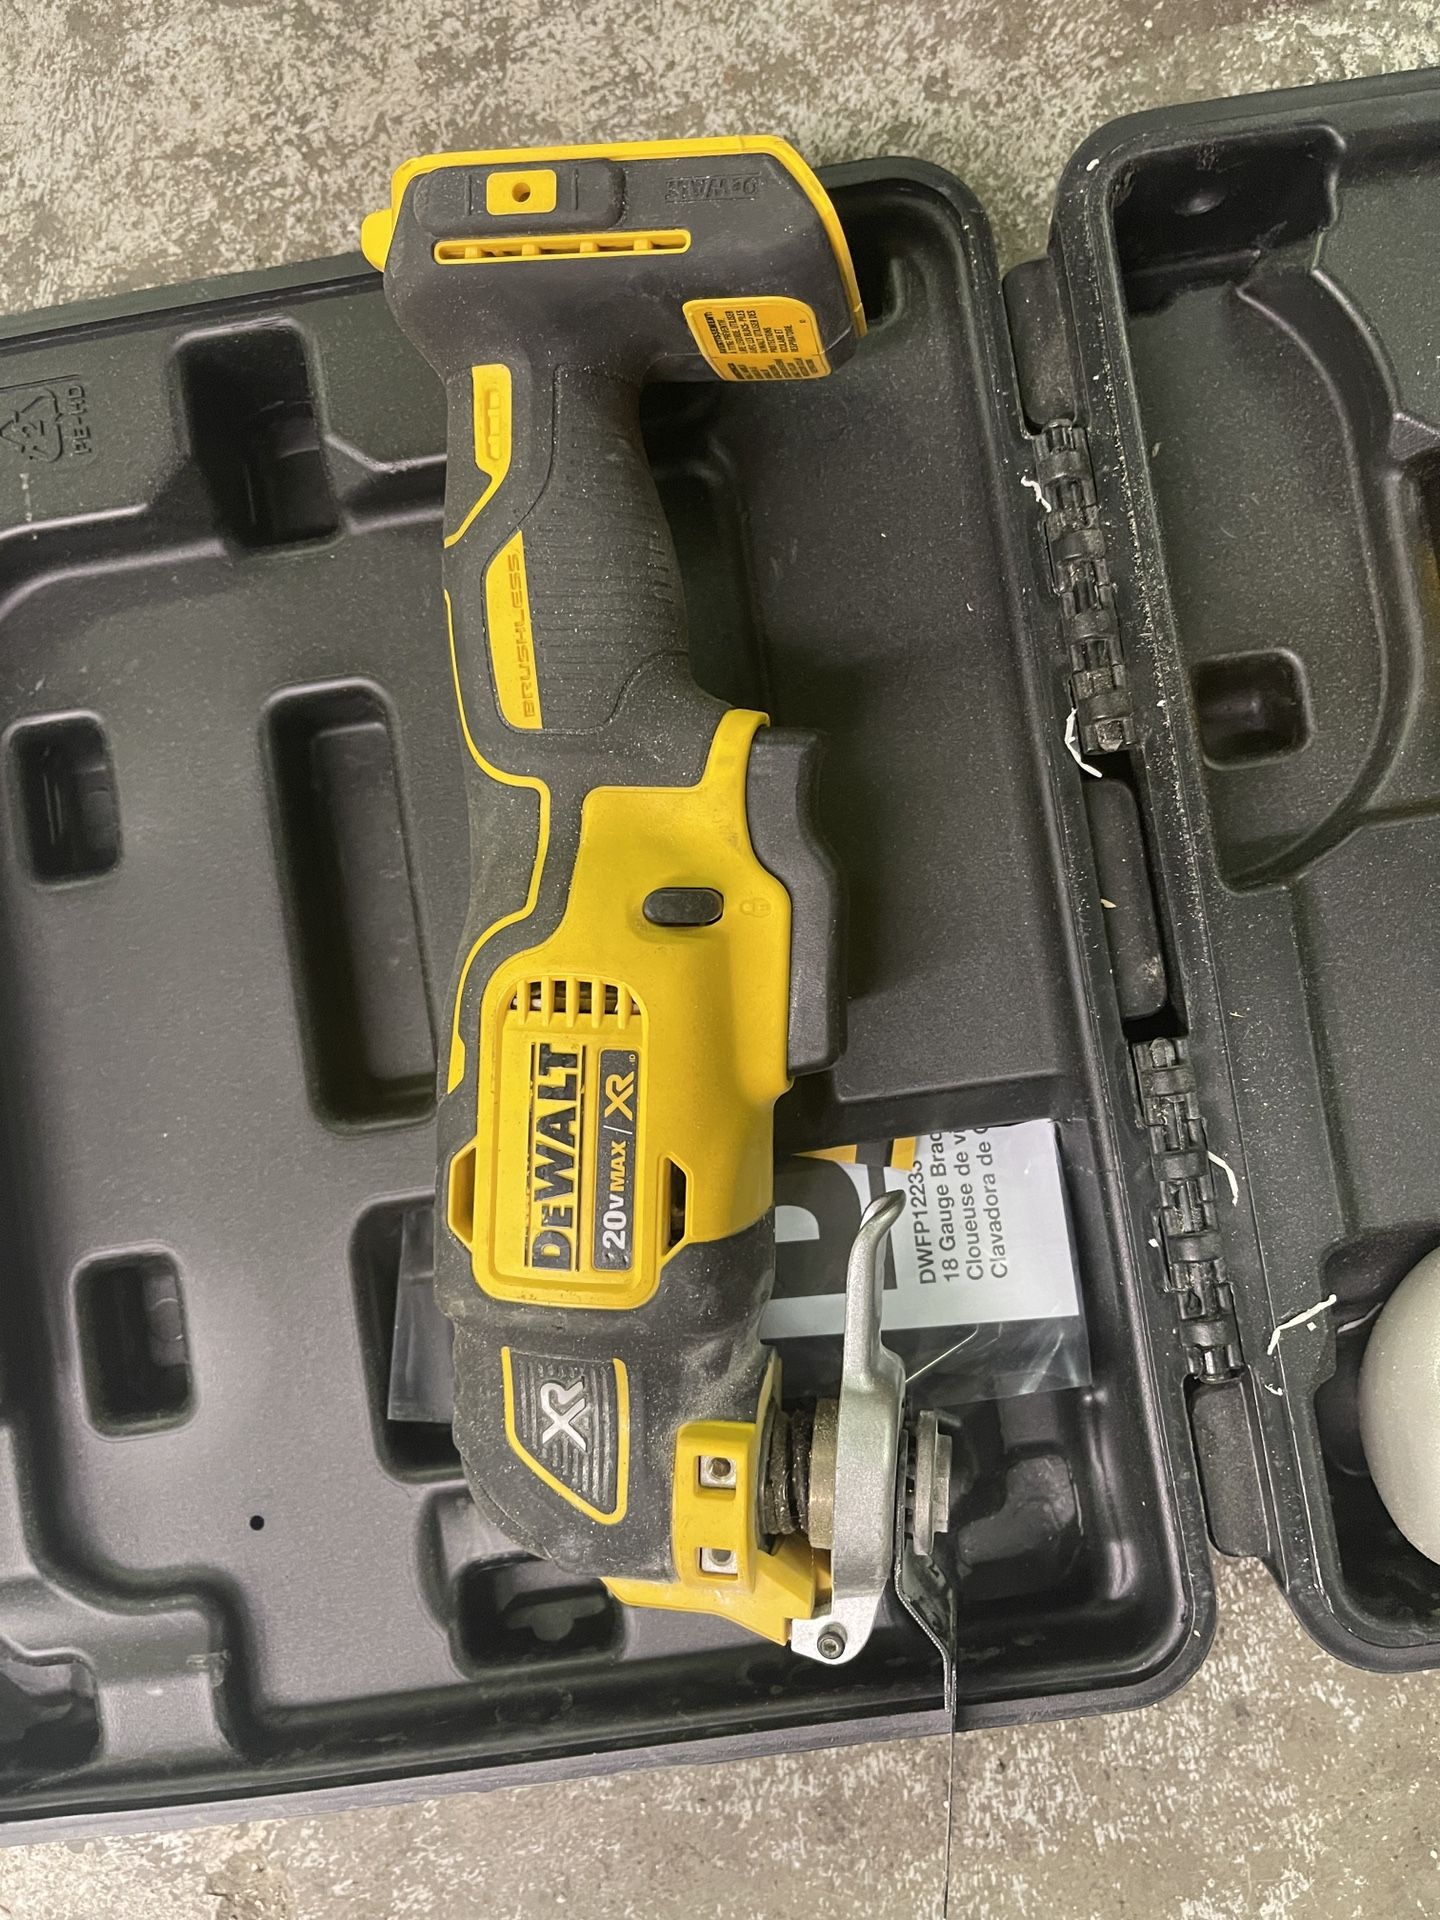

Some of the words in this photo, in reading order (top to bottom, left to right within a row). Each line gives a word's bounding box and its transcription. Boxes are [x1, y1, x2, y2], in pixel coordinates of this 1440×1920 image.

[67, 385, 91, 455] PE-HD
[507, 552, 536, 718] BRUSHLESS
[604, 1071, 634, 1121] XR
[532, 1043, 578, 1271] DEWALT
[609, 1140, 626, 1192] MAX
[954, 1151, 970, 1176] de
[976, 1141, 993, 1166] de
[936, 1183, 956, 1252] Gauge
[960, 1183, 984, 1280] Cloueuse
[983, 1173, 1008, 1279] Clavadora
[942, 1258, 959, 1282] 18
[540, 1376, 587, 1451] XR
